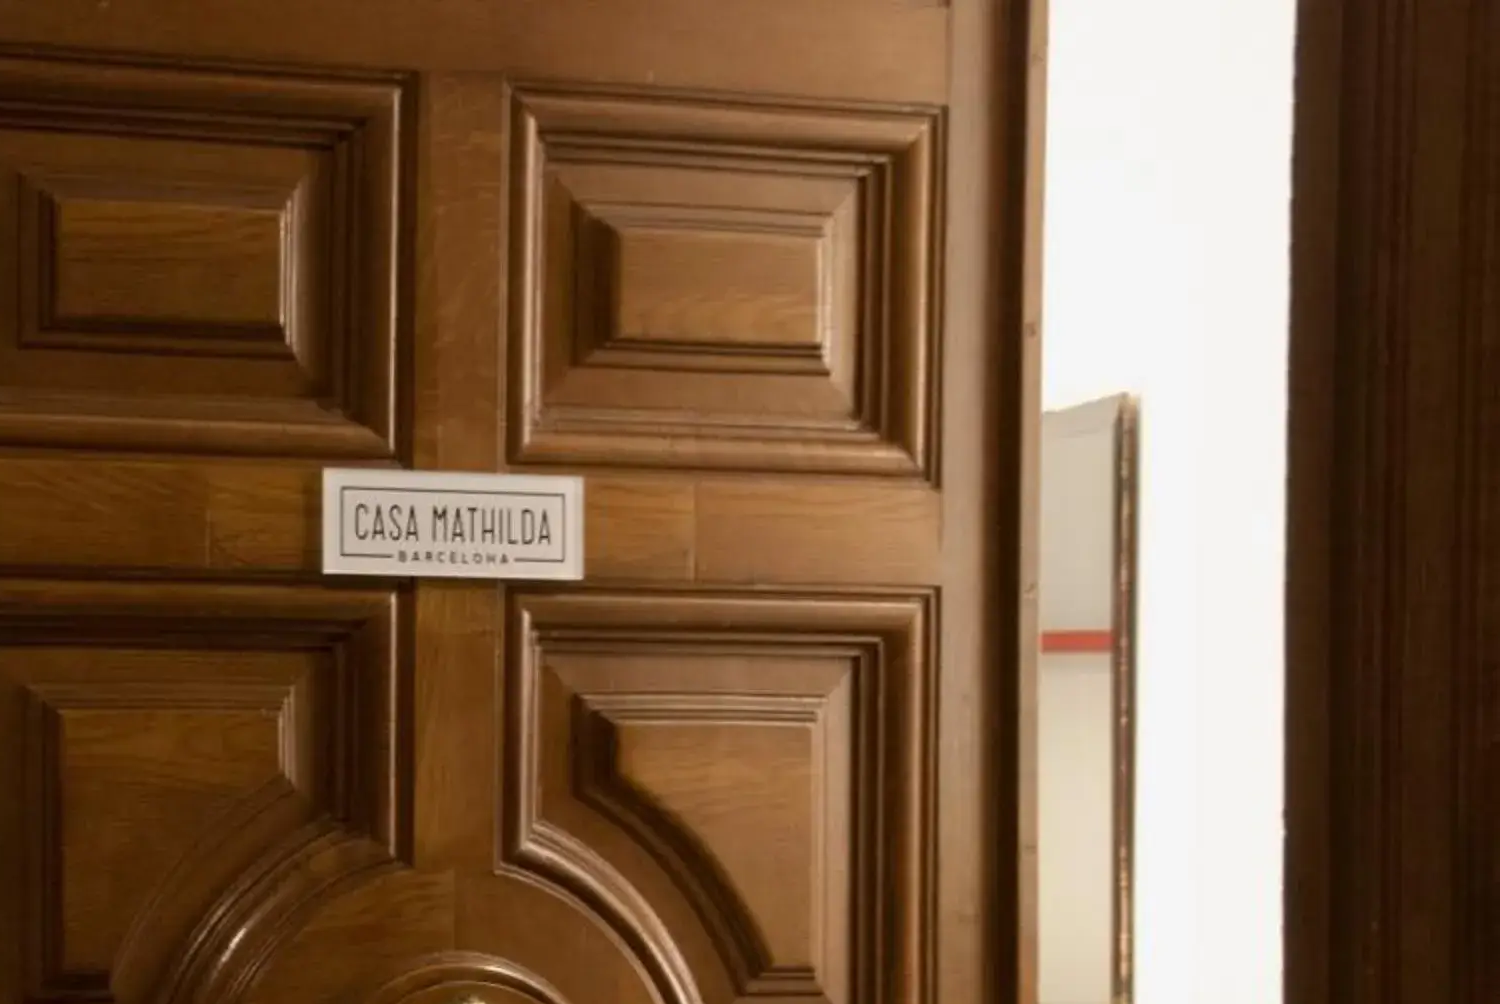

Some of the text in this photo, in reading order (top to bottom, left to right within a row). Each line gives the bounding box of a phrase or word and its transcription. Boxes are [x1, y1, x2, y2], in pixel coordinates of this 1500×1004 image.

[355, 503, 551, 545] CASA MATHILDA
[398, 550, 509, 564] BARCELONA
